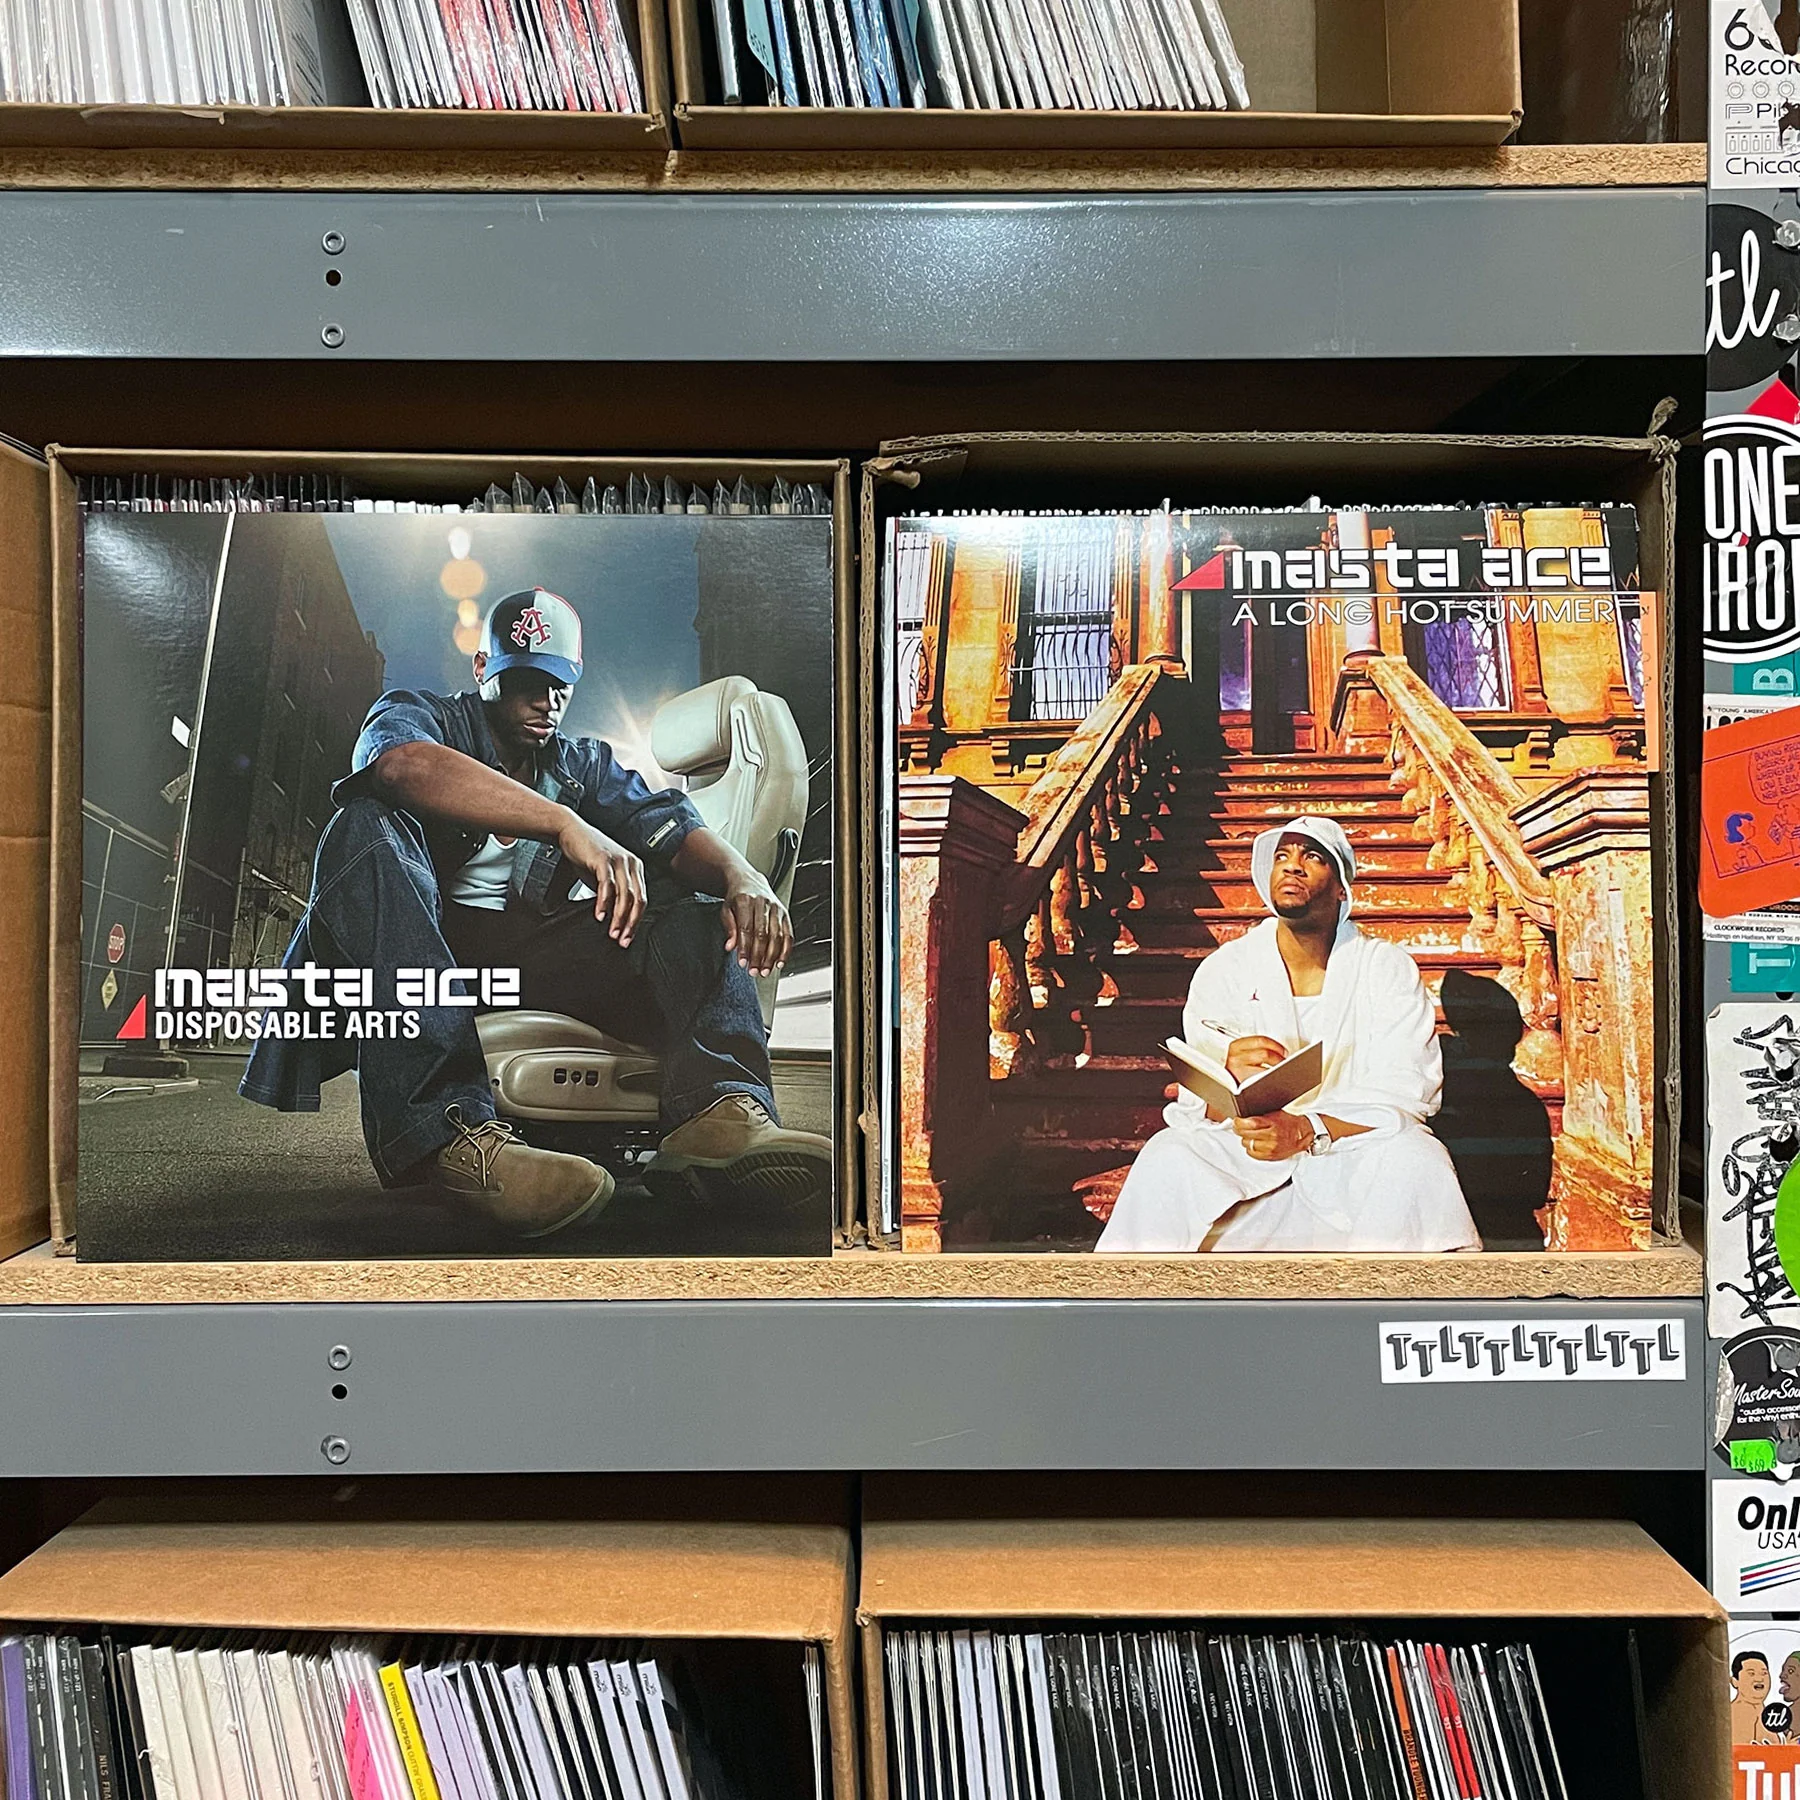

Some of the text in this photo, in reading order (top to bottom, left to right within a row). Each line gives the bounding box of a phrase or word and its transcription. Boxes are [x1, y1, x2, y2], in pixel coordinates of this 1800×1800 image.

[1704, 445, 1800, 540] ONE
[1232, 599, 1614, 626] A LONG HOT SUMMER
[1713, 924, 1785, 933] CLOCKWORK RECORDS
[155, 1011, 421, 1040] DISPOSABLE ARTS
[1736, 1416, 1748, 1424] for
[1737, 1496, 1800, 1531] Onl
[387, 1682, 403, 1716] STURGILL
[398, 1717, 413, 1750] SIMPSON
[1402, 1729, 1420, 1768] BRANDEE
[98, 1754, 109, 1776] NILS
